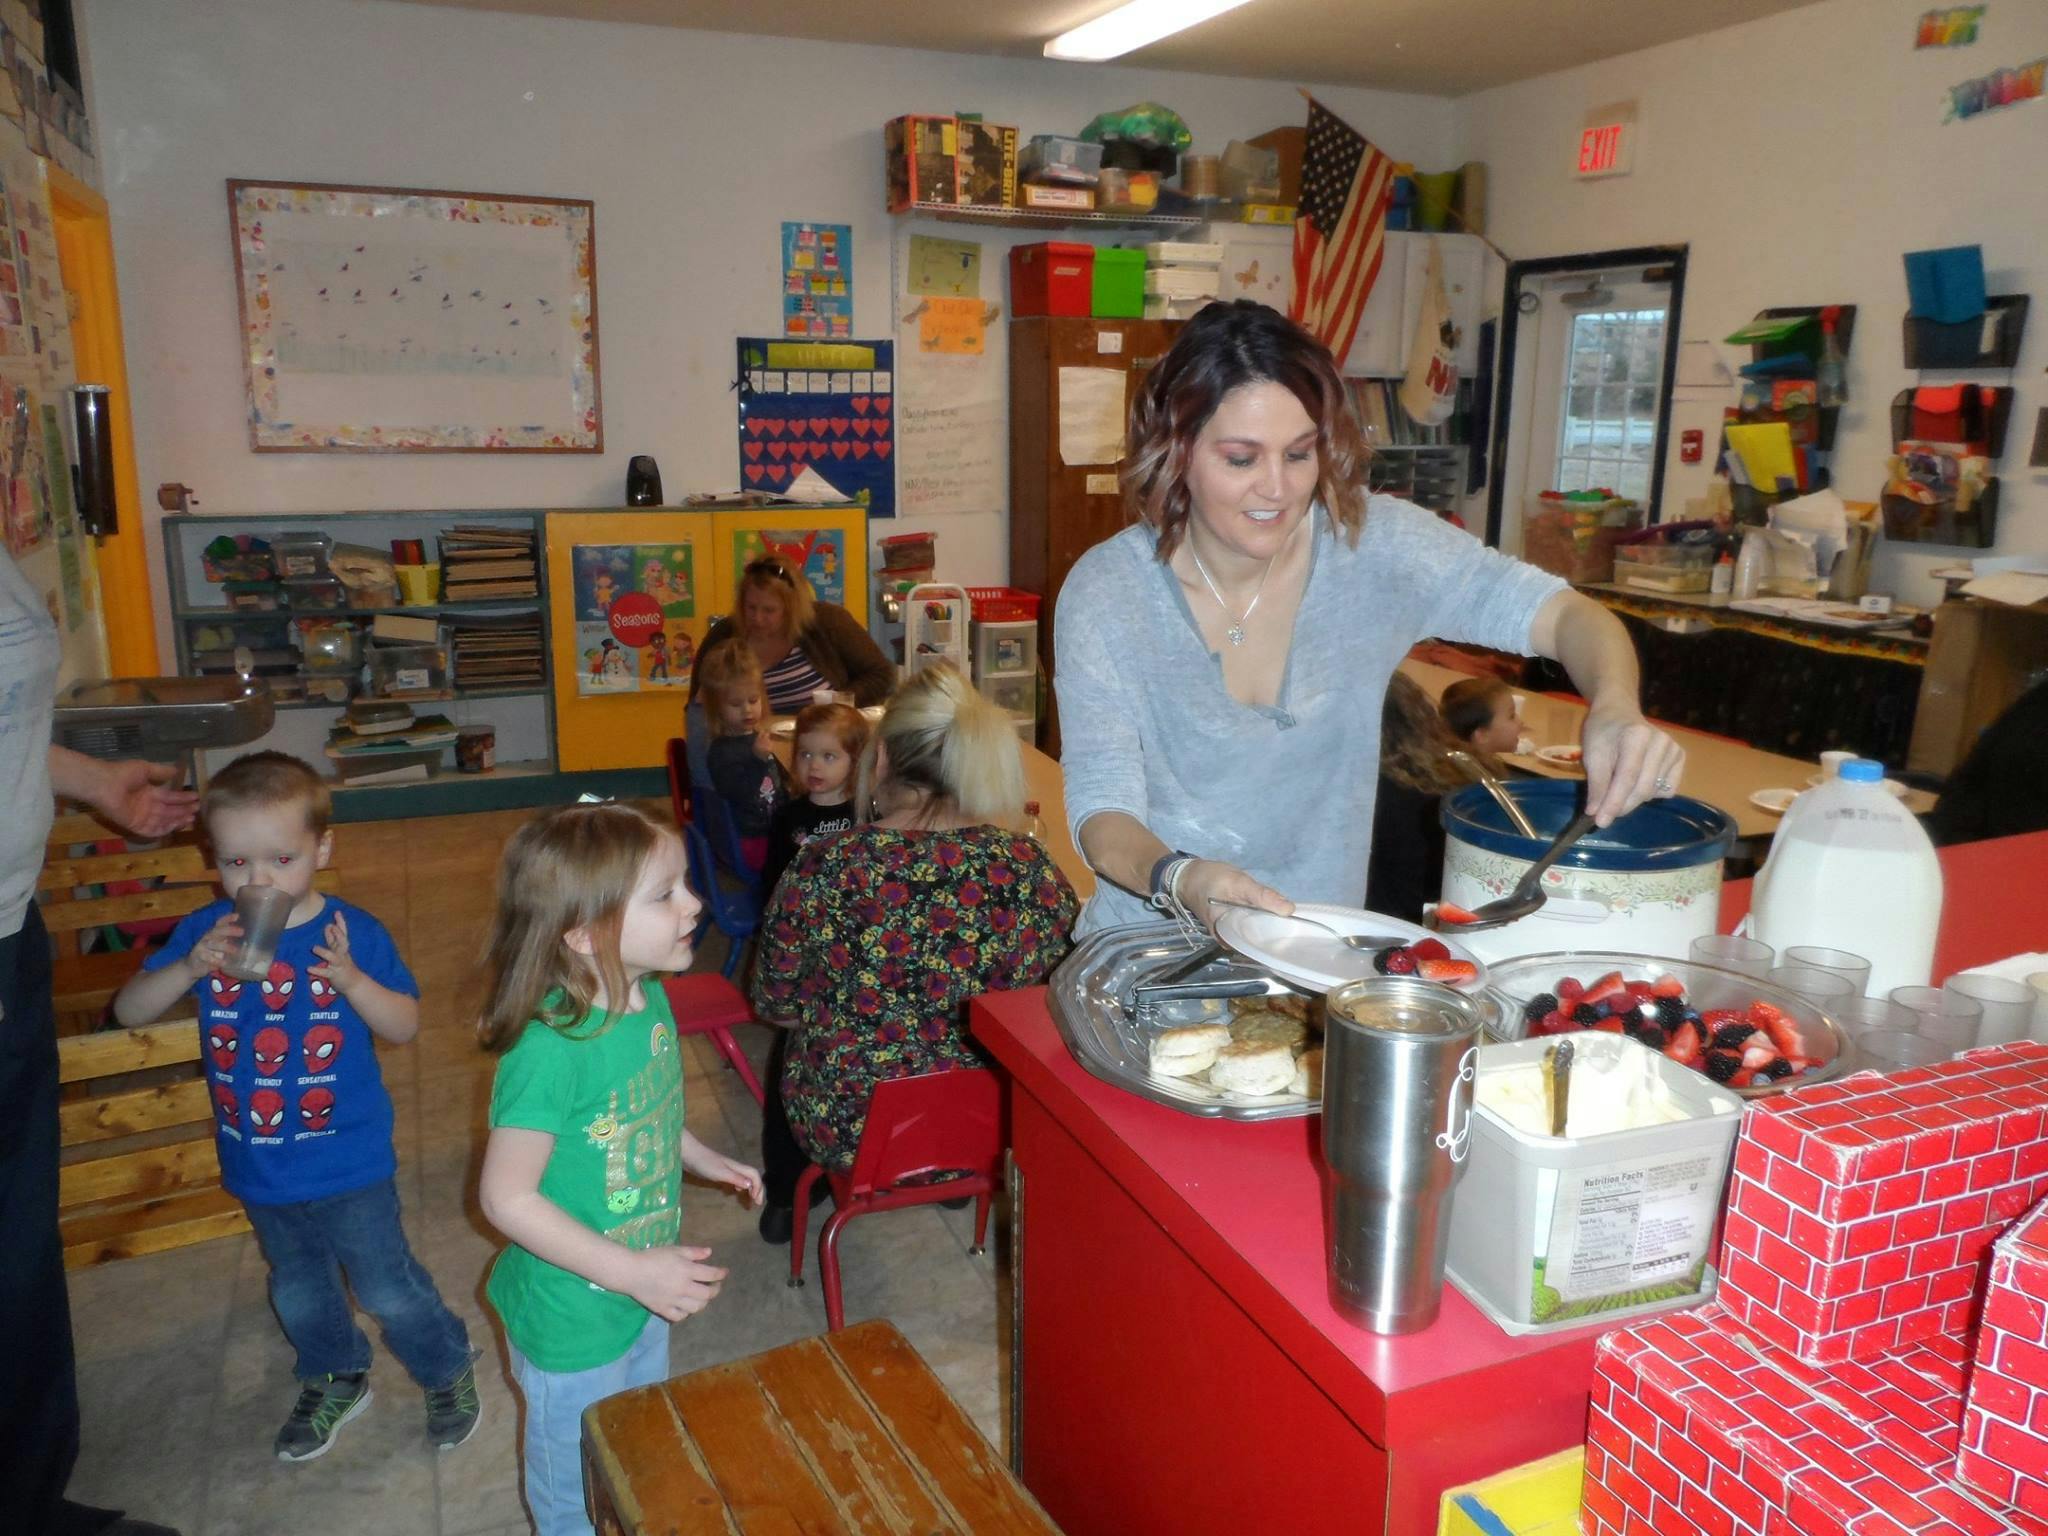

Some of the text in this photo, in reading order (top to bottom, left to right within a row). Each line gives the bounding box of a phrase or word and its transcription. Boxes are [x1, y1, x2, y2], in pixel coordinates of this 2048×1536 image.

[1580, 124, 1621, 171] EXIT
[613, 612, 661, 629] Seasons
[813, 818, 851, 834] little
[210, 1009, 239, 1020] AMAZING
[264, 1012, 286, 1022] HAPPY
[309, 1011, 340, 1020] STARTLED
[254, 1077, 283, 1087] FRIENDLY
[297, 1074, 337, 1085] SENSATIONAL
[251, 1136, 284, 1145] CONFIDENT
[1584, 1171, 1644, 1188] Nutrition Facts
